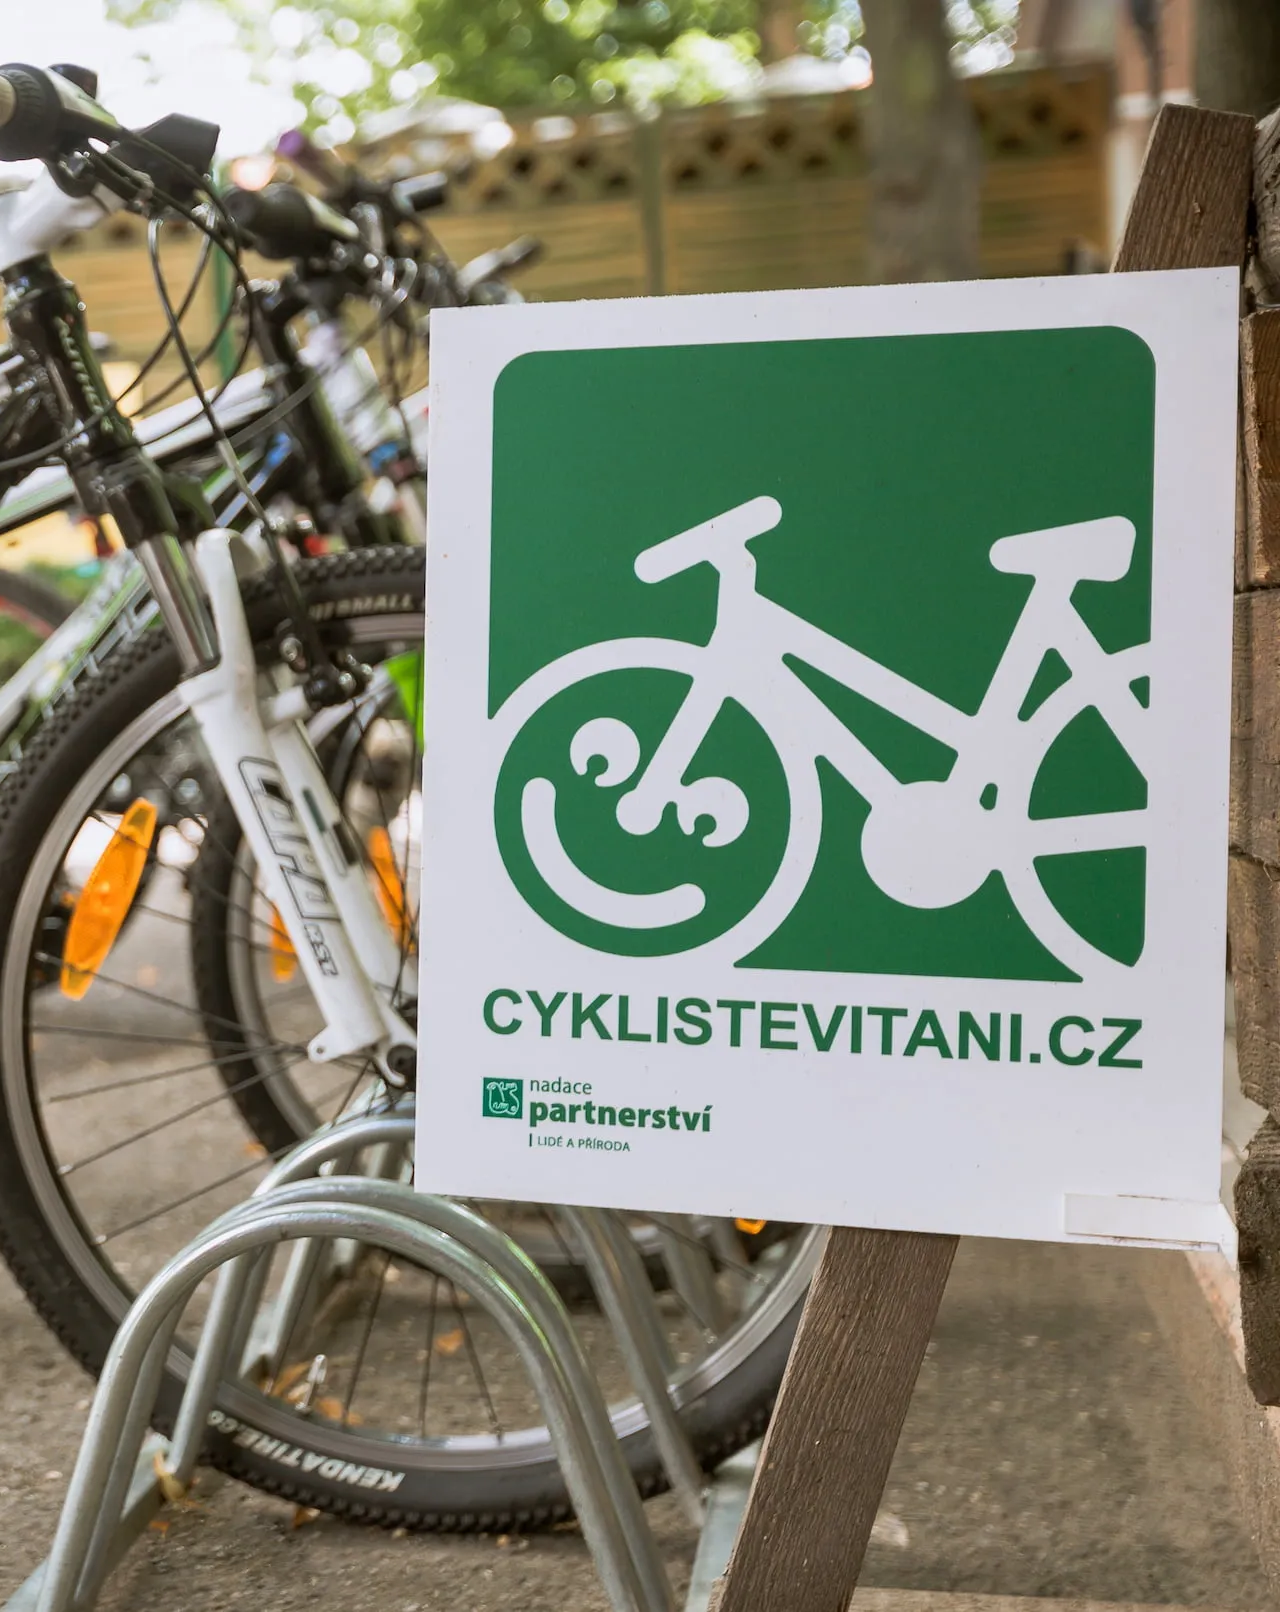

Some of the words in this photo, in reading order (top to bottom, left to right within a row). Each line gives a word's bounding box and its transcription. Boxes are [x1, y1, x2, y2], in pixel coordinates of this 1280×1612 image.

[483, 988, 1143, 1069] CYKLISTEVITANI.CZ
[529, 1077, 592, 1095] nadace
[529, 1100, 713, 1132] partnerství
[537, 1134, 563, 1147] LIDÉ
[566, 1137, 575, 1148] A
[578, 1136, 630, 1151] PŘÍRODA
[207, 1409, 406, 1493] KENDATIRE.CO
